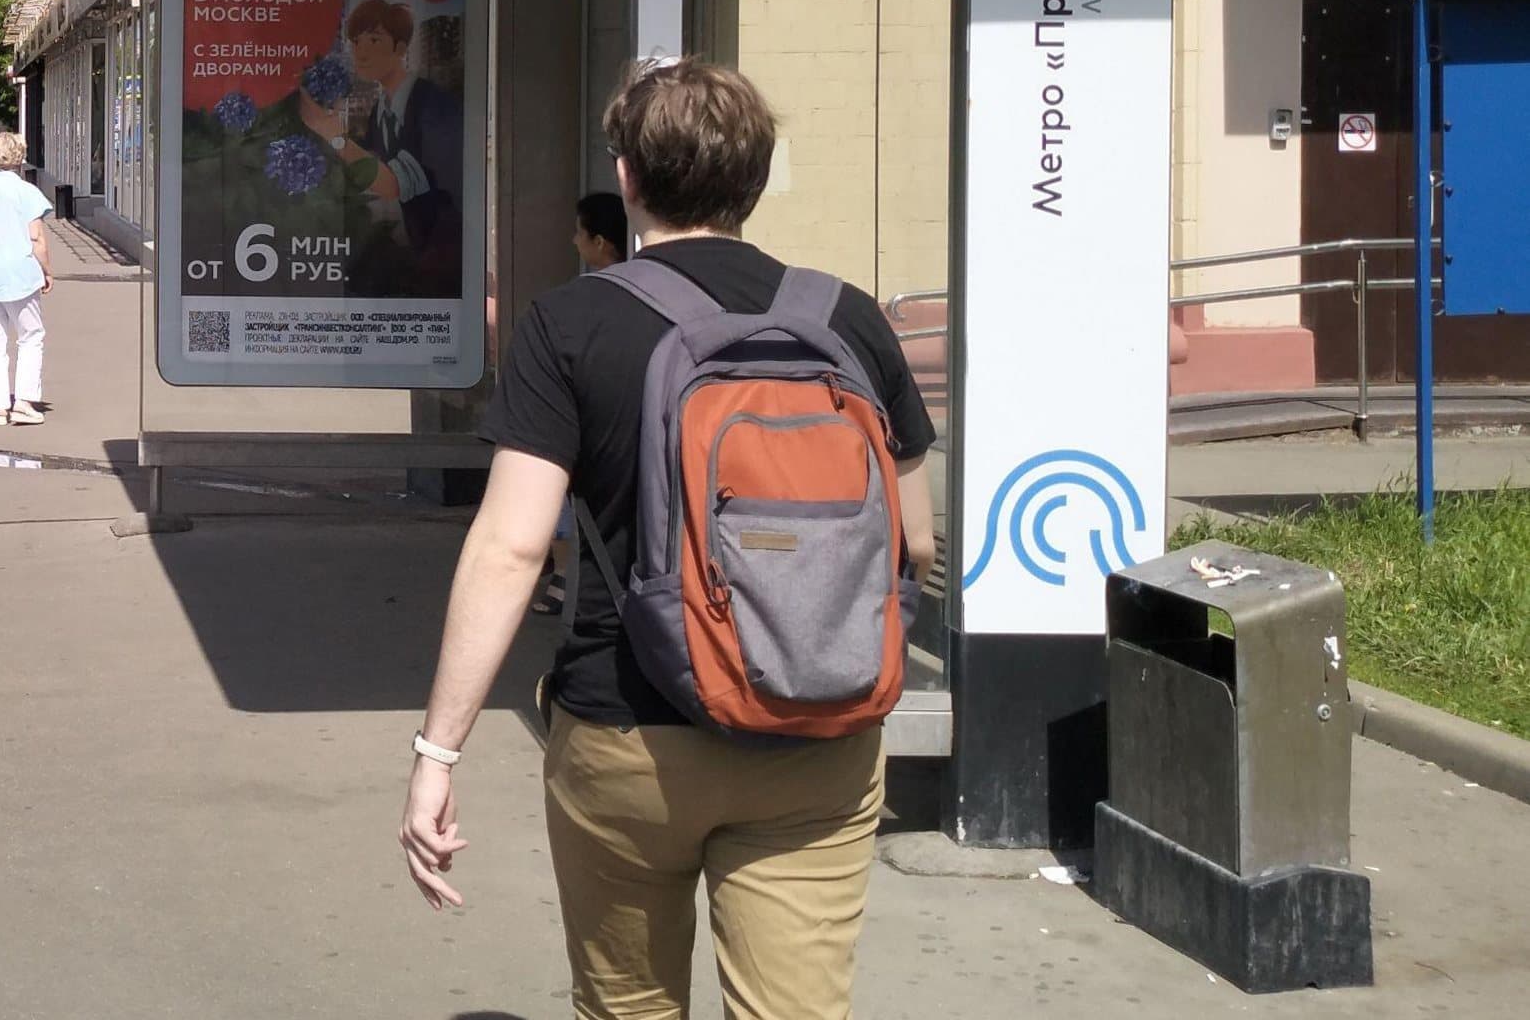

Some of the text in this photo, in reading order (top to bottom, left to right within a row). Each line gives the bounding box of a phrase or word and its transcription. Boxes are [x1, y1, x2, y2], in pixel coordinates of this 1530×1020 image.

[194, 6, 281, 22] МОСКВЕ
[193, 41, 309, 58] С ЗЕЛЁНЫМИ
[193, 62, 282, 78] ДВОРАМИ
[1032, 84, 1071, 217] Метро
[187, 223, 351, 282] ОТ 6 МЛН
[291, 261, 350, 281] РУБ.
